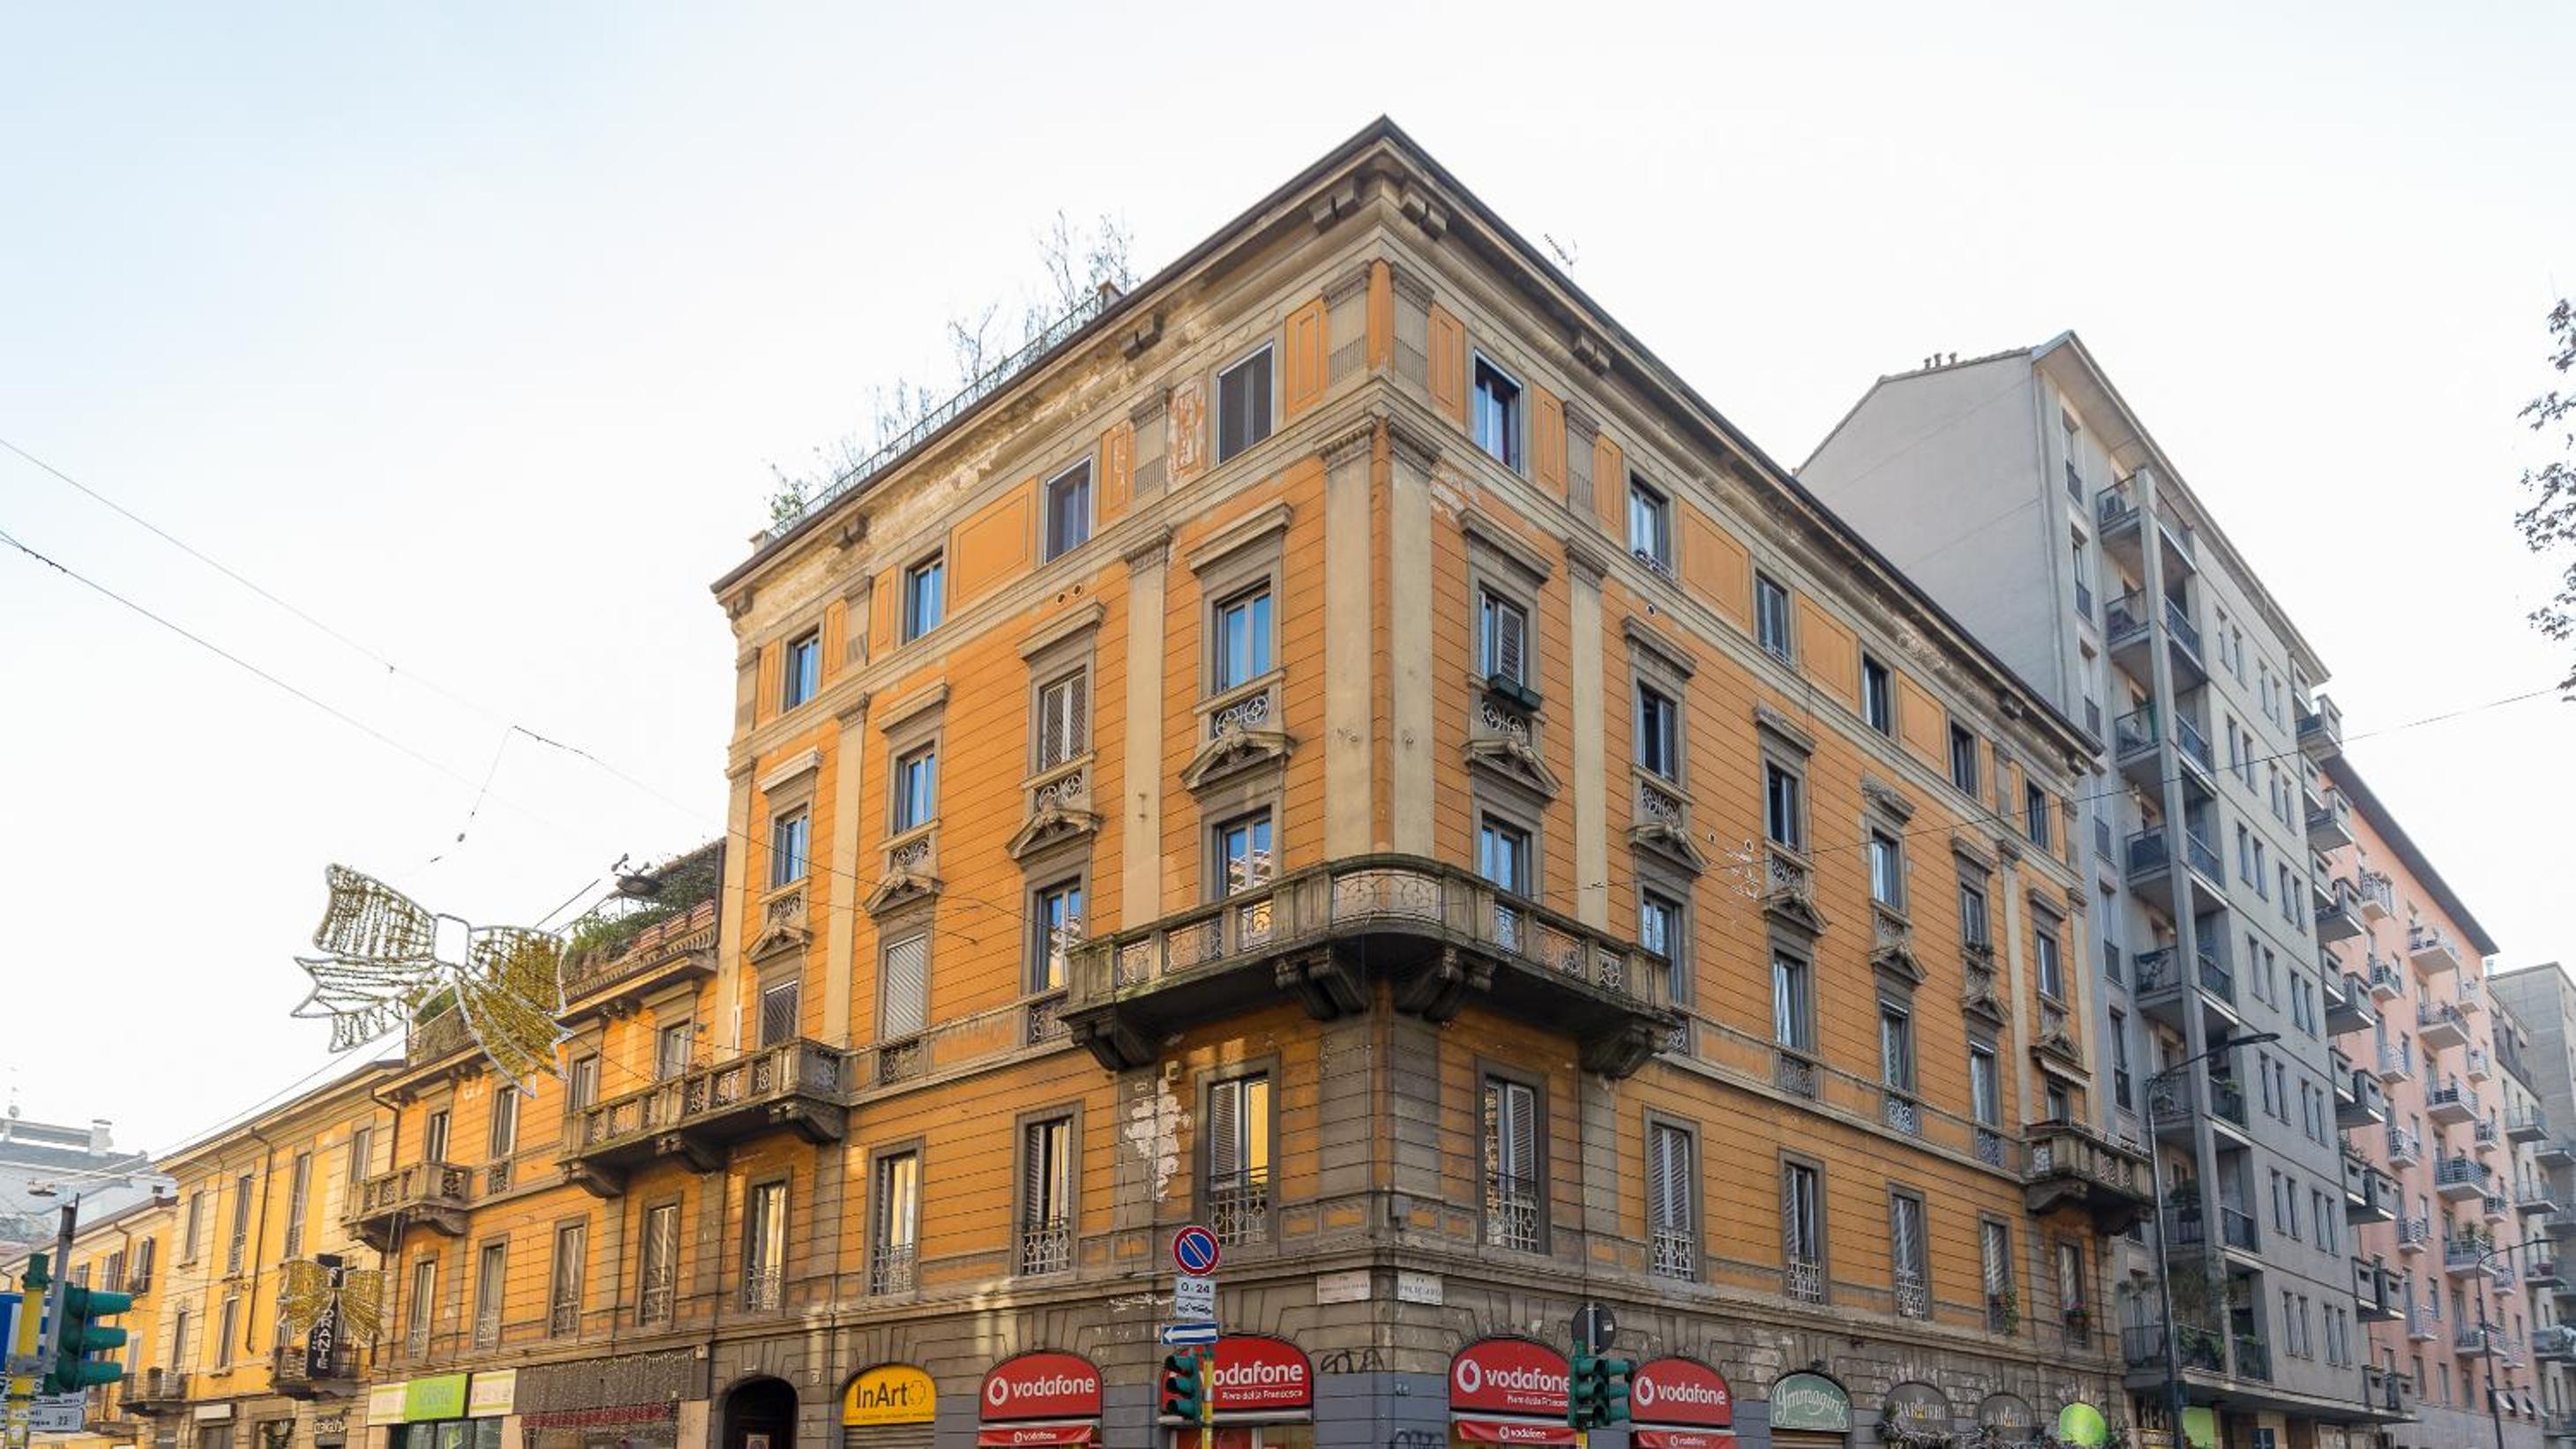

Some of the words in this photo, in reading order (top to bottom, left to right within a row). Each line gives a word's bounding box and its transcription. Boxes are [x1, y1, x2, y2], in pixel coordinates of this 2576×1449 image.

[1180, 1281, 1189, 1292] 0
[1195, 1283, 1210, 1293] 24
[856, 1381, 908, 1408] InArt
[1012, 1374, 1096, 1399] vodafone
[1657, 1381, 1726, 1405] vodafone
[1022, 1431, 1057, 1441] vodafone
[1510, 1427, 1546, 1439] vodafone
